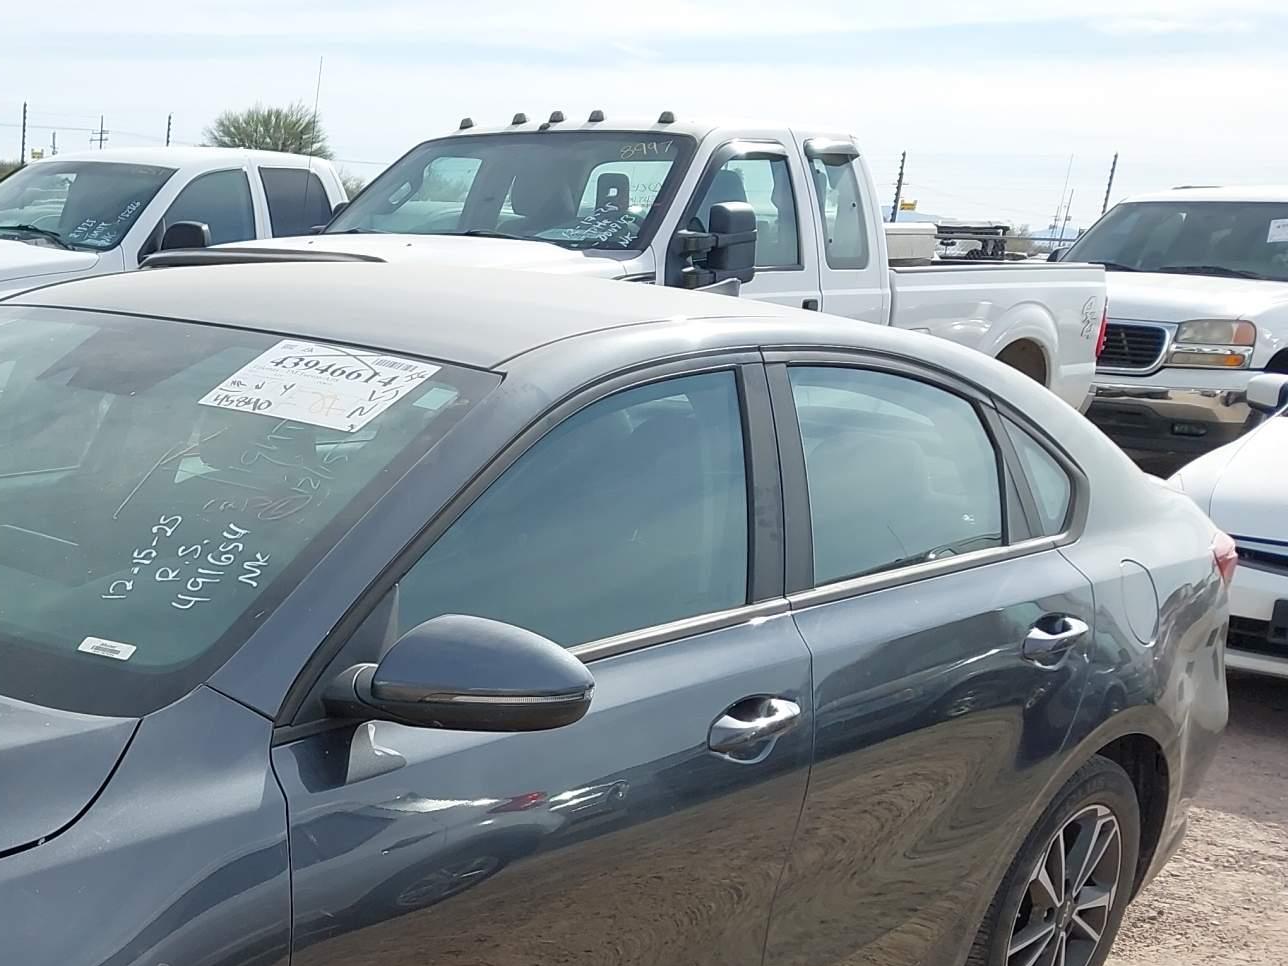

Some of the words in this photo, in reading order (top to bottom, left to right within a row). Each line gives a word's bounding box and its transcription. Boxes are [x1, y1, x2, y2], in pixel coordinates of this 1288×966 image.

[269, 355, 400, 387] 43946614
[213, 393, 273, 412] 45840
[171, 522, 251, 609] 491654
